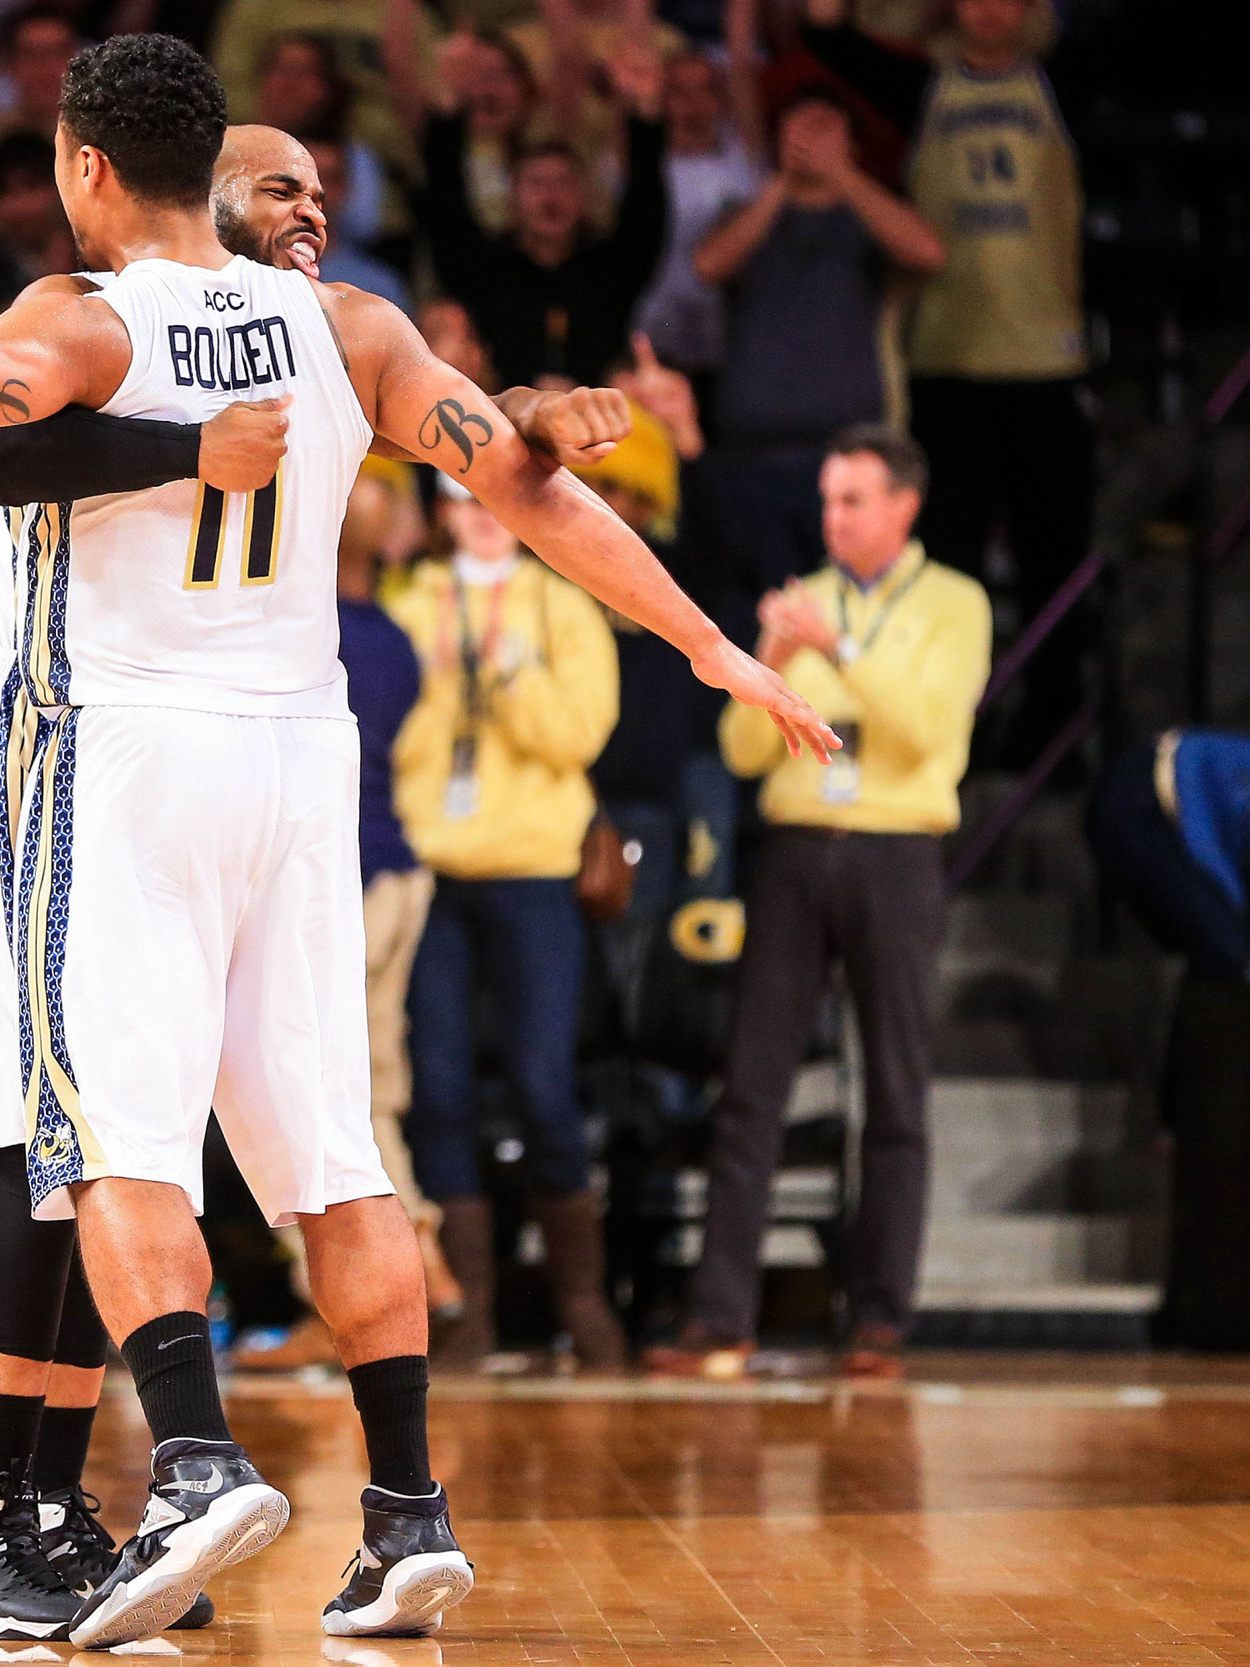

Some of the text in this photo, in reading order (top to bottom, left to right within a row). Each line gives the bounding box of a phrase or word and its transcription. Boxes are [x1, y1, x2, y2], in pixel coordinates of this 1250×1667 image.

[204, 290, 245, 312] ACC
[168, 316, 296, 391] BOLDEN
[418, 398, 494, 474] B
